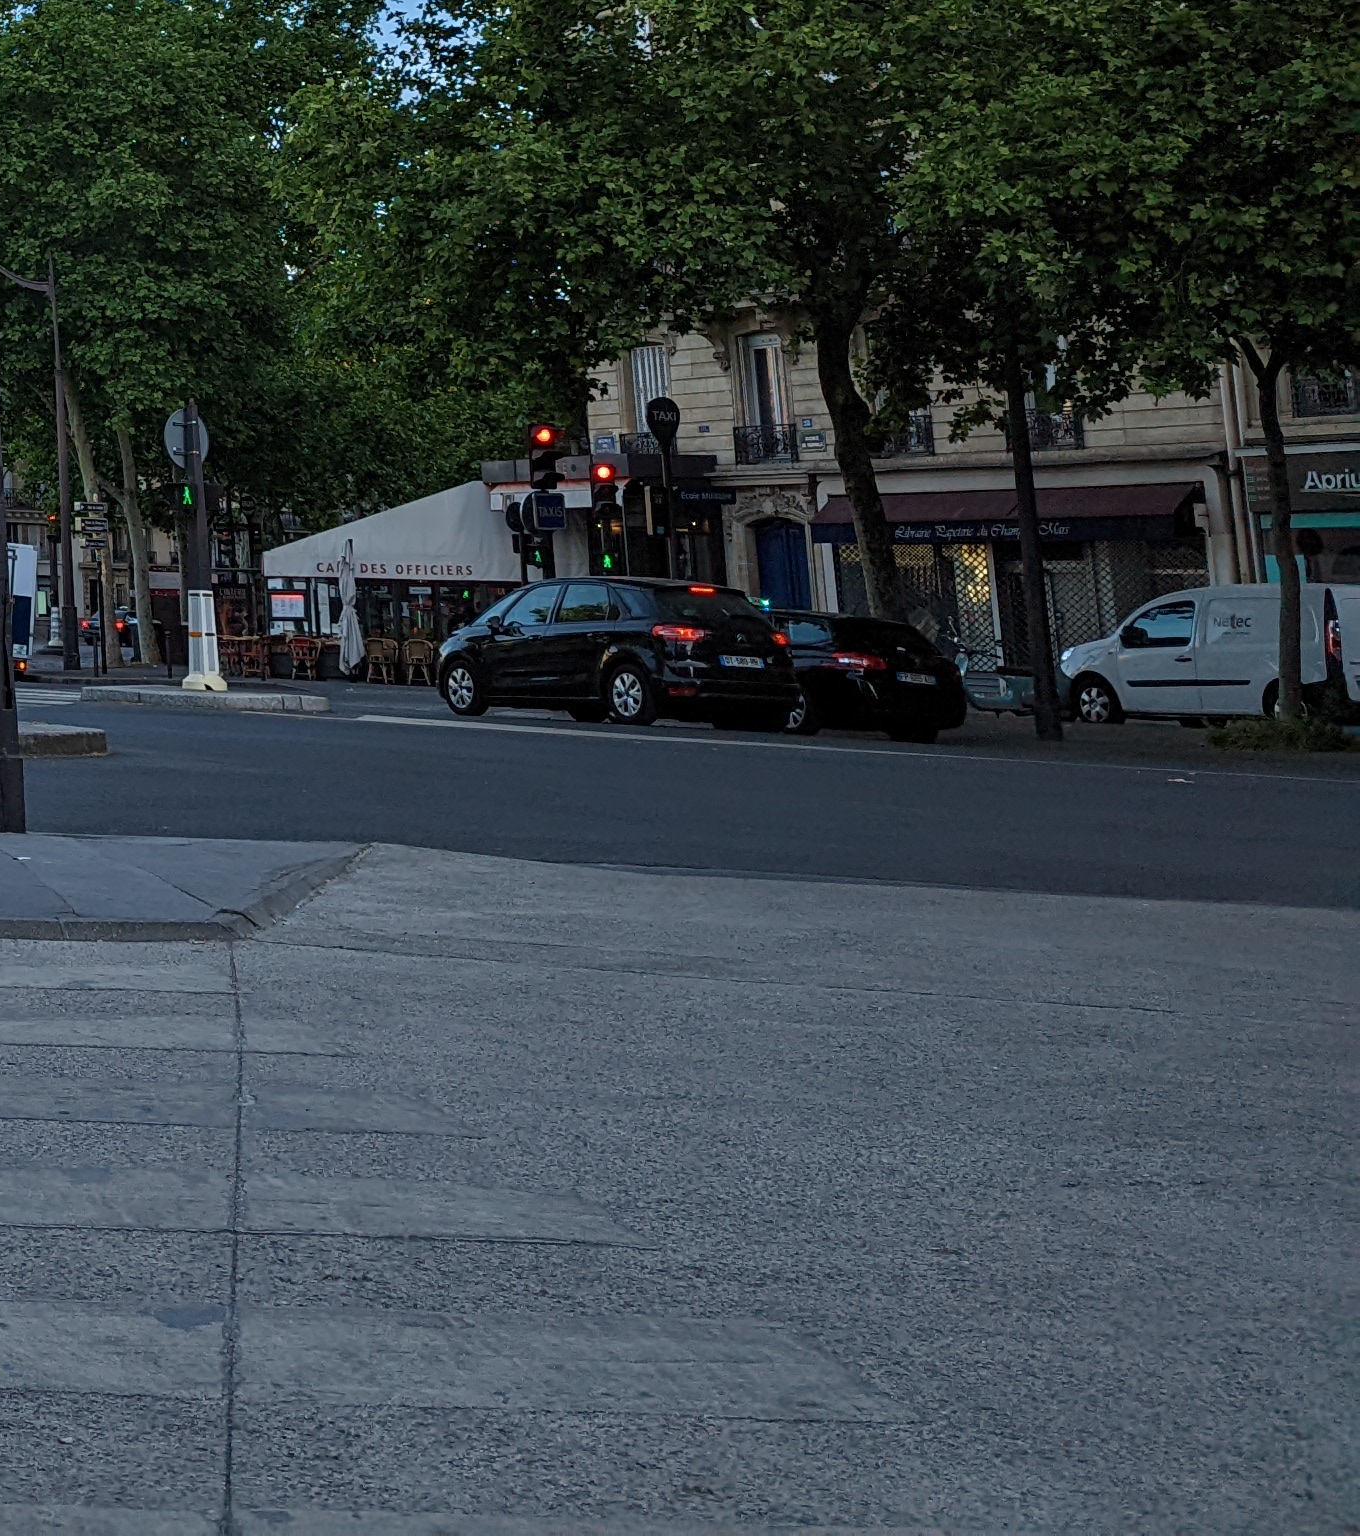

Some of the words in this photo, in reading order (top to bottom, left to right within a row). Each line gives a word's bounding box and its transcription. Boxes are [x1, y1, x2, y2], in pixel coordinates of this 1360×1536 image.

[651, 410, 677, 421] TAXI
[537, 506, 563, 517] TAXIS
[1038, 522, 1070, 536] Mars
[360, 563, 387, 575] DES
[395, 564, 473, 576] OFFICIERS
